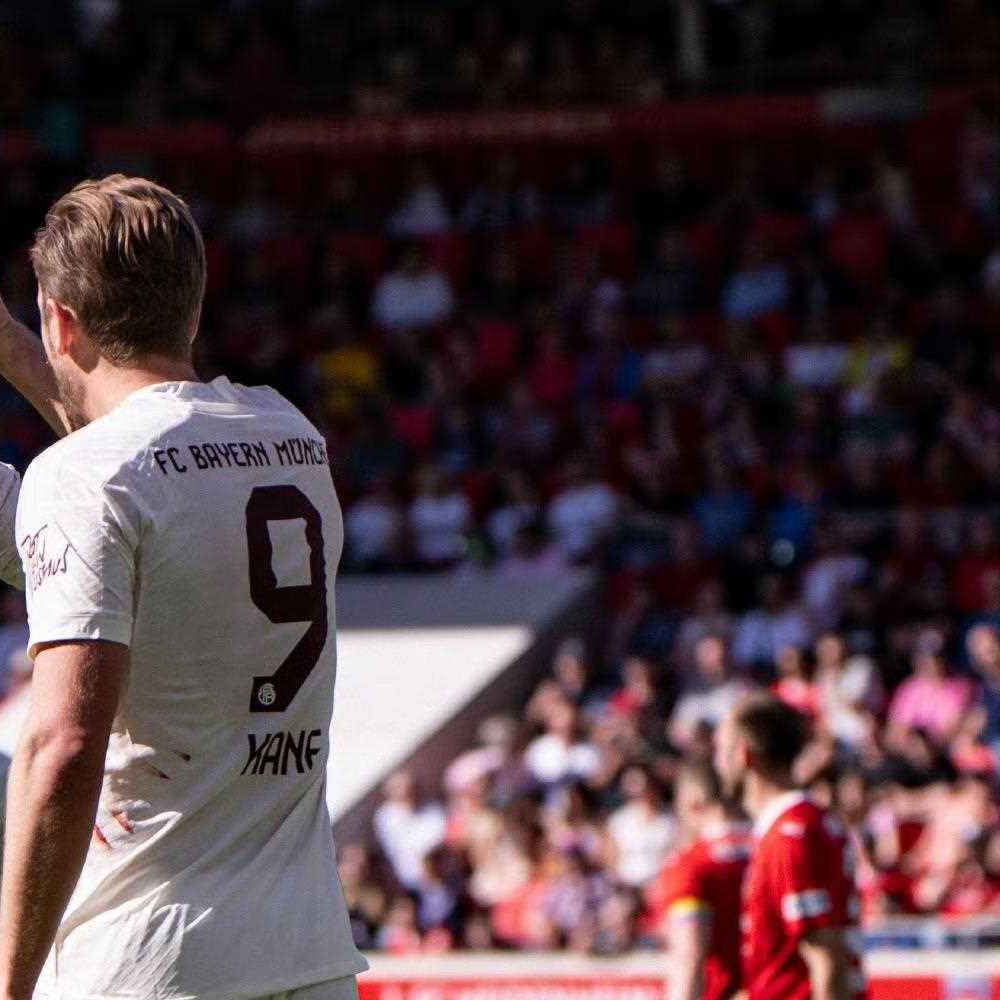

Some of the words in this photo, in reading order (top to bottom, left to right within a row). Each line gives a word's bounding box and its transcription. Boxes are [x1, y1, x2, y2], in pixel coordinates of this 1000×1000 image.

[153, 446, 188, 475] FC
[187, 441, 271, 470] BAYERN
[246, 484, 328, 712] 9
